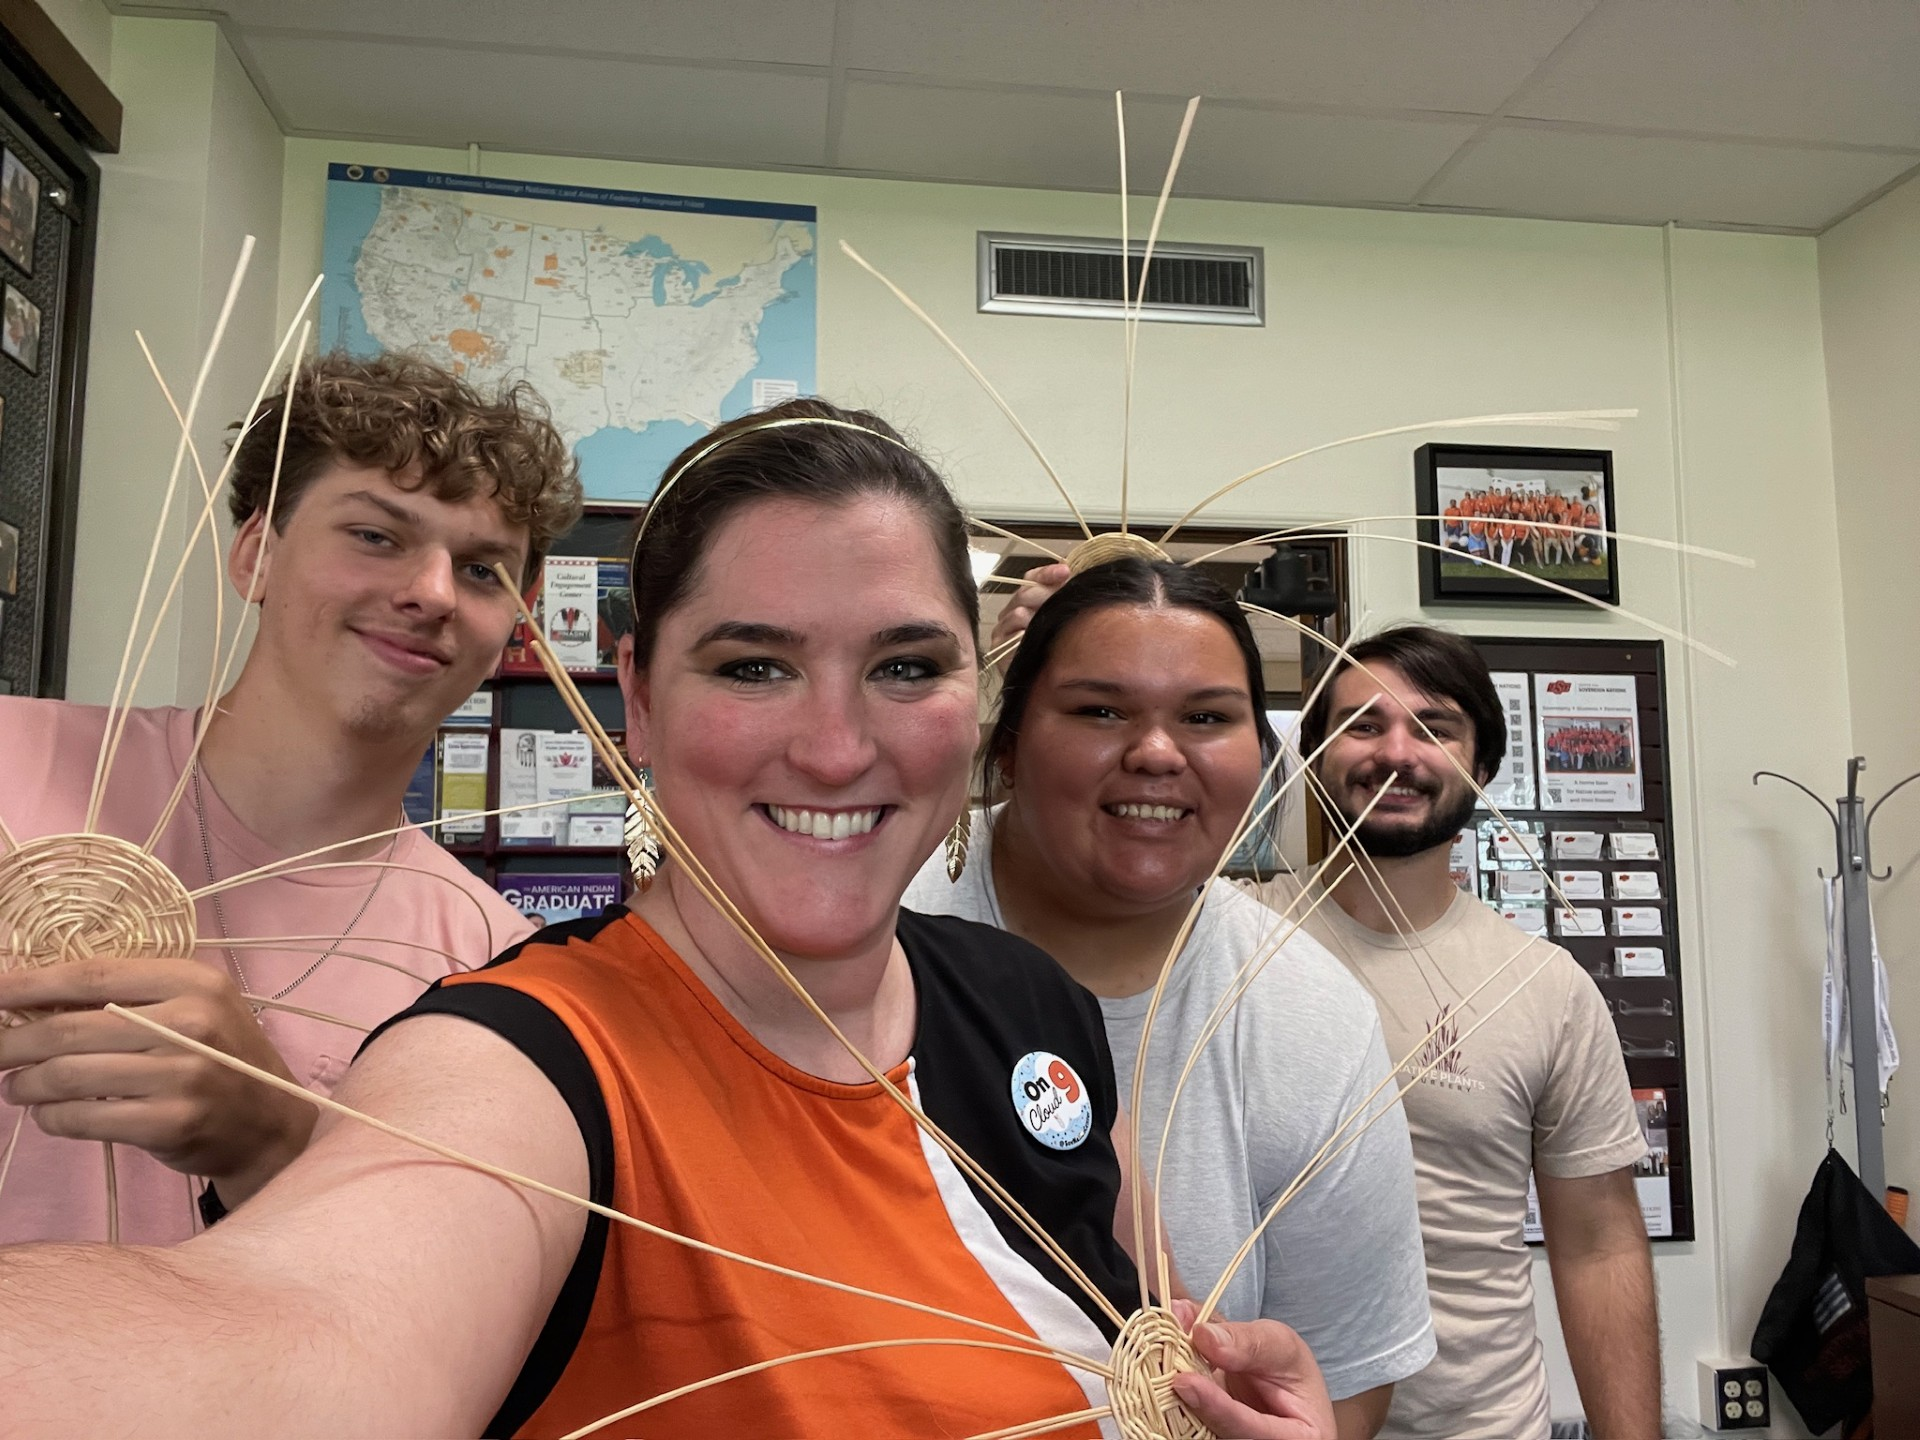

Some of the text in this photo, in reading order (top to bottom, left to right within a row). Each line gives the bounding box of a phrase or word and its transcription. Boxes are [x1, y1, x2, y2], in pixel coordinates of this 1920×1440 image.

[550, 582, 592, 590] Engagement
[556, 573, 586, 581] Cultural
[502, 888, 615, 910] GRADUATE
[531, 885, 581, 894] AMERICAN
[582, 884, 615, 893] INDIAN
[1024, 1077, 1050, 1101] On
[1048, 1060, 1080, 1104] 9
[1440, 1070, 1485, 1090] PLANTS
[1029, 1087, 1062, 1131] Cloud
